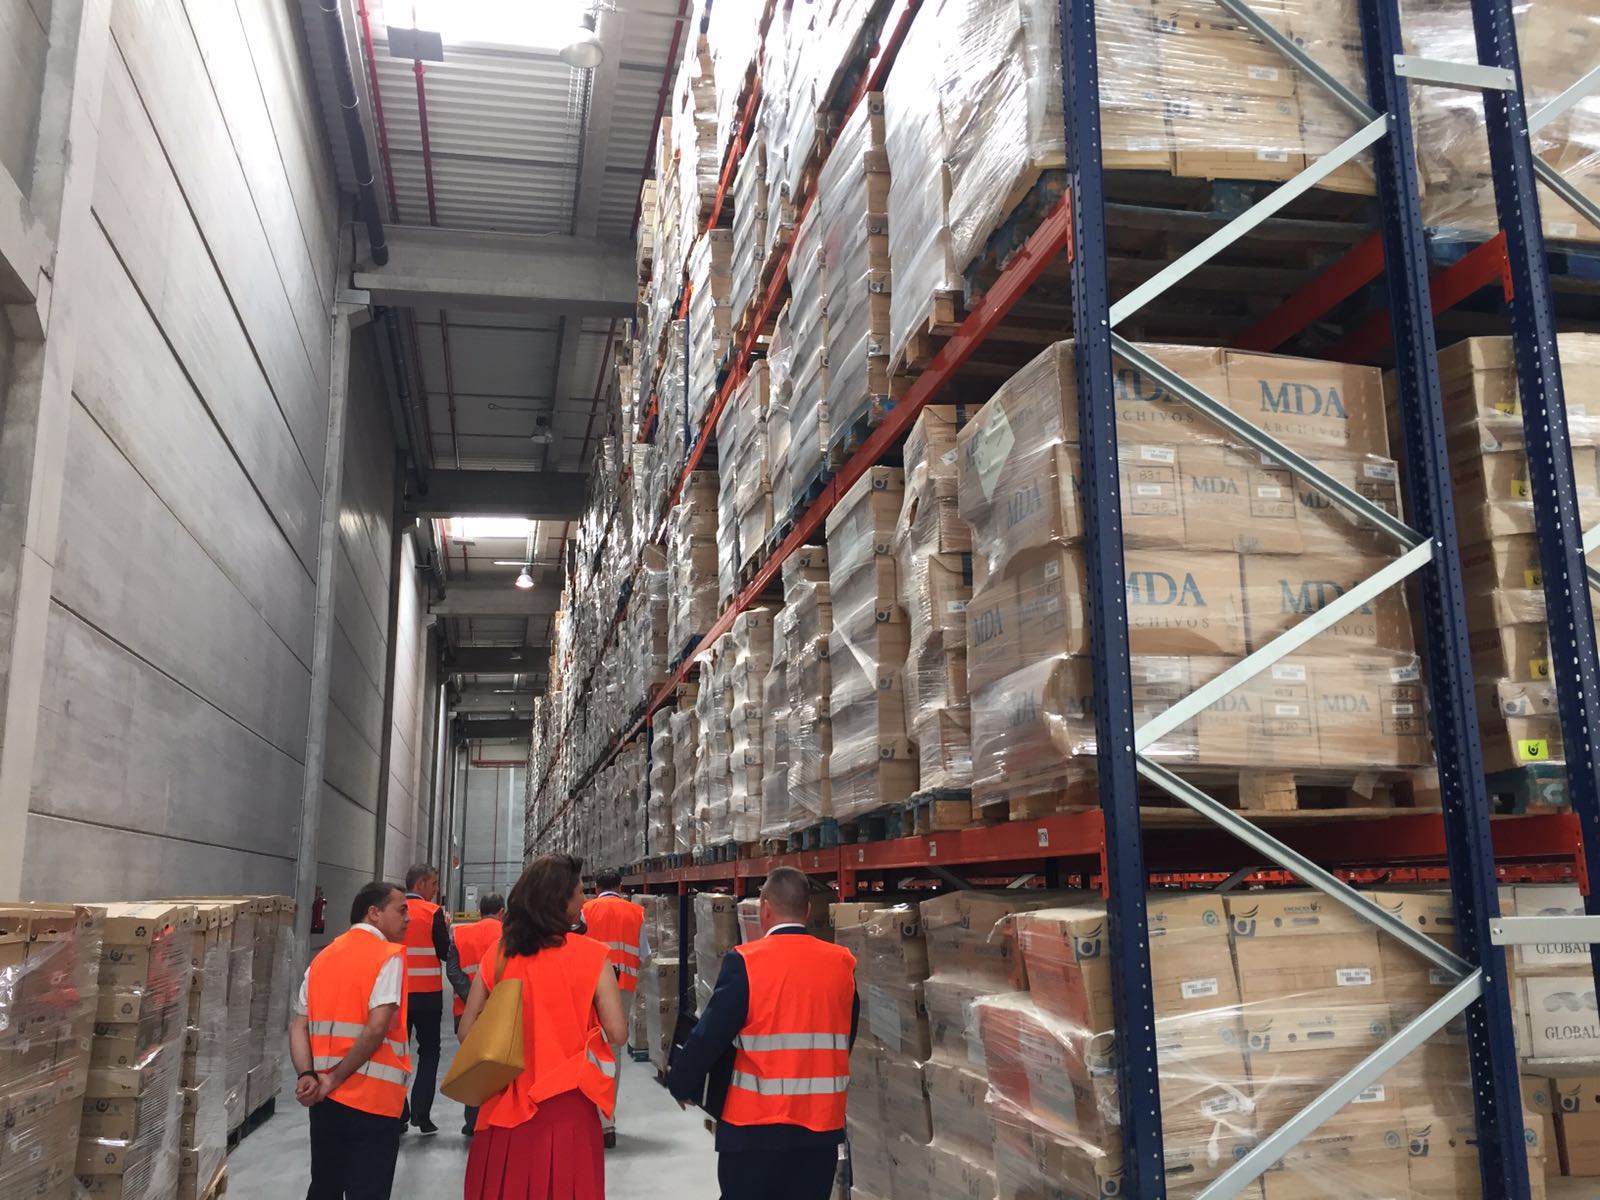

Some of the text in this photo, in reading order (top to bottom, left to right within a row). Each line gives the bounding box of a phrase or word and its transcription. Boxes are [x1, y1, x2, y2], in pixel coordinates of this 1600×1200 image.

[1258, 380, 1349, 420] MDA
[1122, 410, 1195, 424] CHIVOS
[1191, 476, 1241, 496] MDA
[973, 605, 1005, 648] MDA
[1134, 615, 1210, 630] CHIVOS
[1321, 694, 1371, 713] MDA
[1536, 942, 1591, 954] GLOBAL
[1545, 1025, 1600, 1041] GLOBAL
